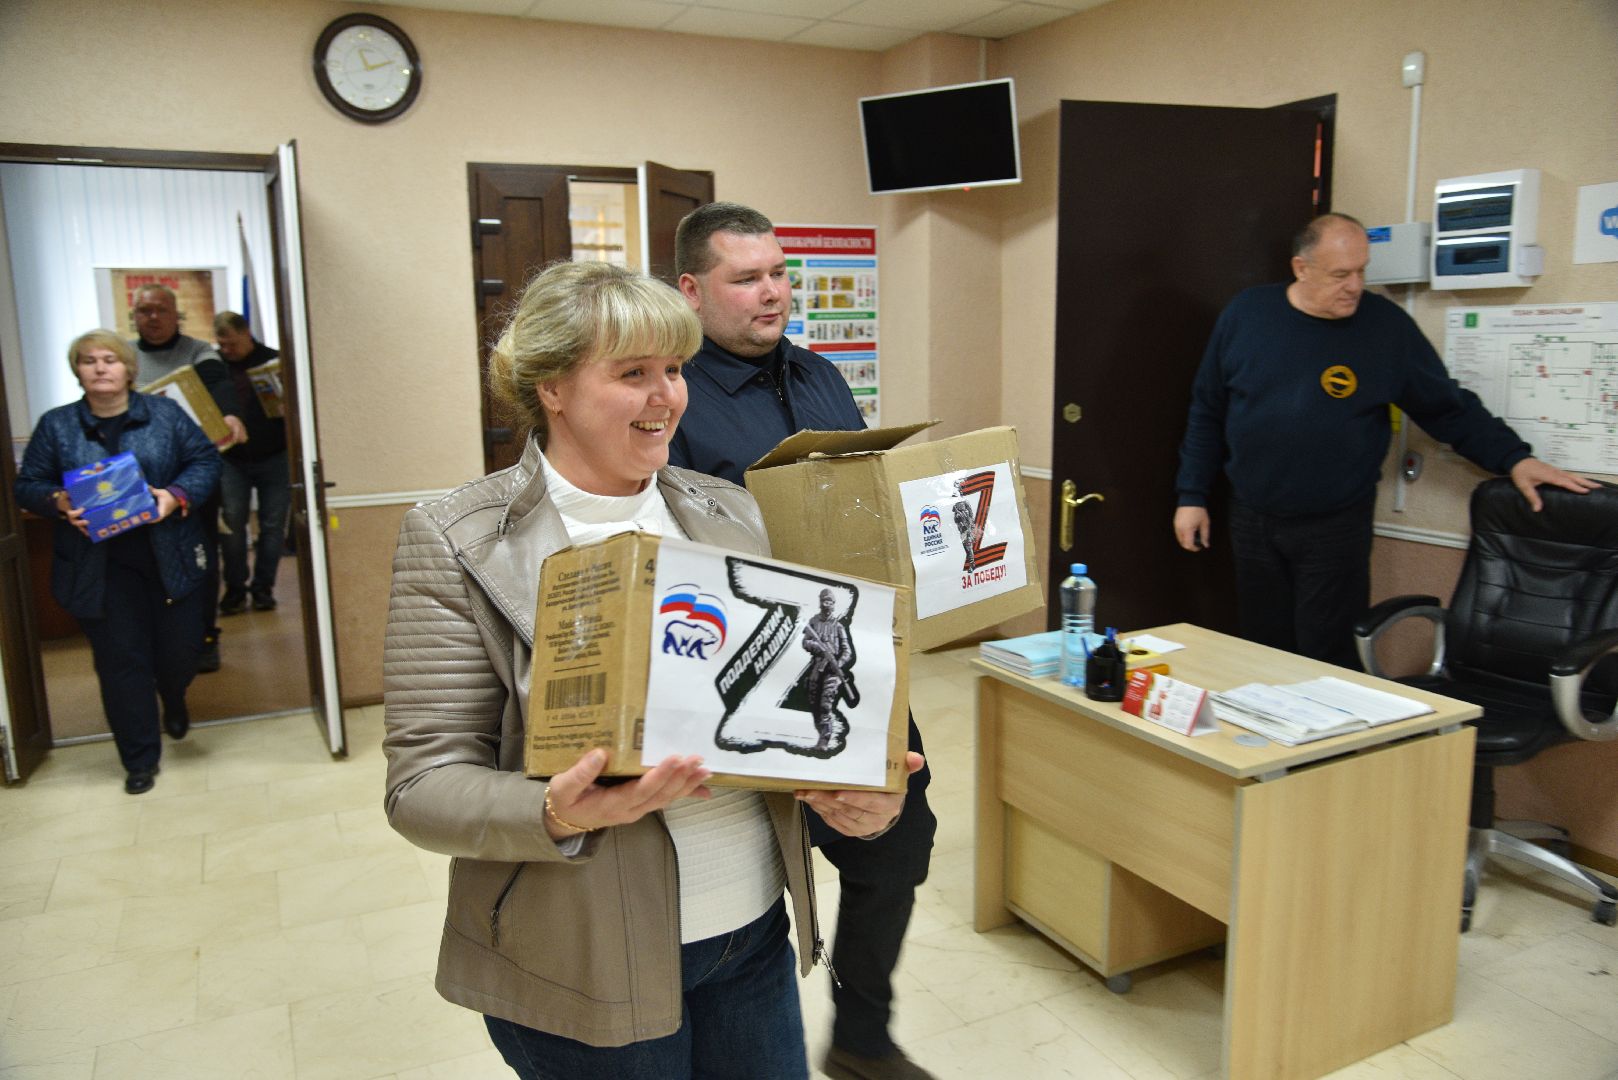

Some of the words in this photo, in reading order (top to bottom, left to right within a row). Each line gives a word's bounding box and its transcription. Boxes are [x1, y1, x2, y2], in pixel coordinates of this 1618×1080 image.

[923, 533, 943, 542] ЕДИНАЯ
[924, 539, 944, 548] РОССИЯ
[961, 574, 973, 590] ЗА
[974, 565, 1007, 585] ПОБЕДУ!
[719, 605, 785, 694] ПОДДЕРЖИМ
[753, 615, 794, 675] НАШИХ!
